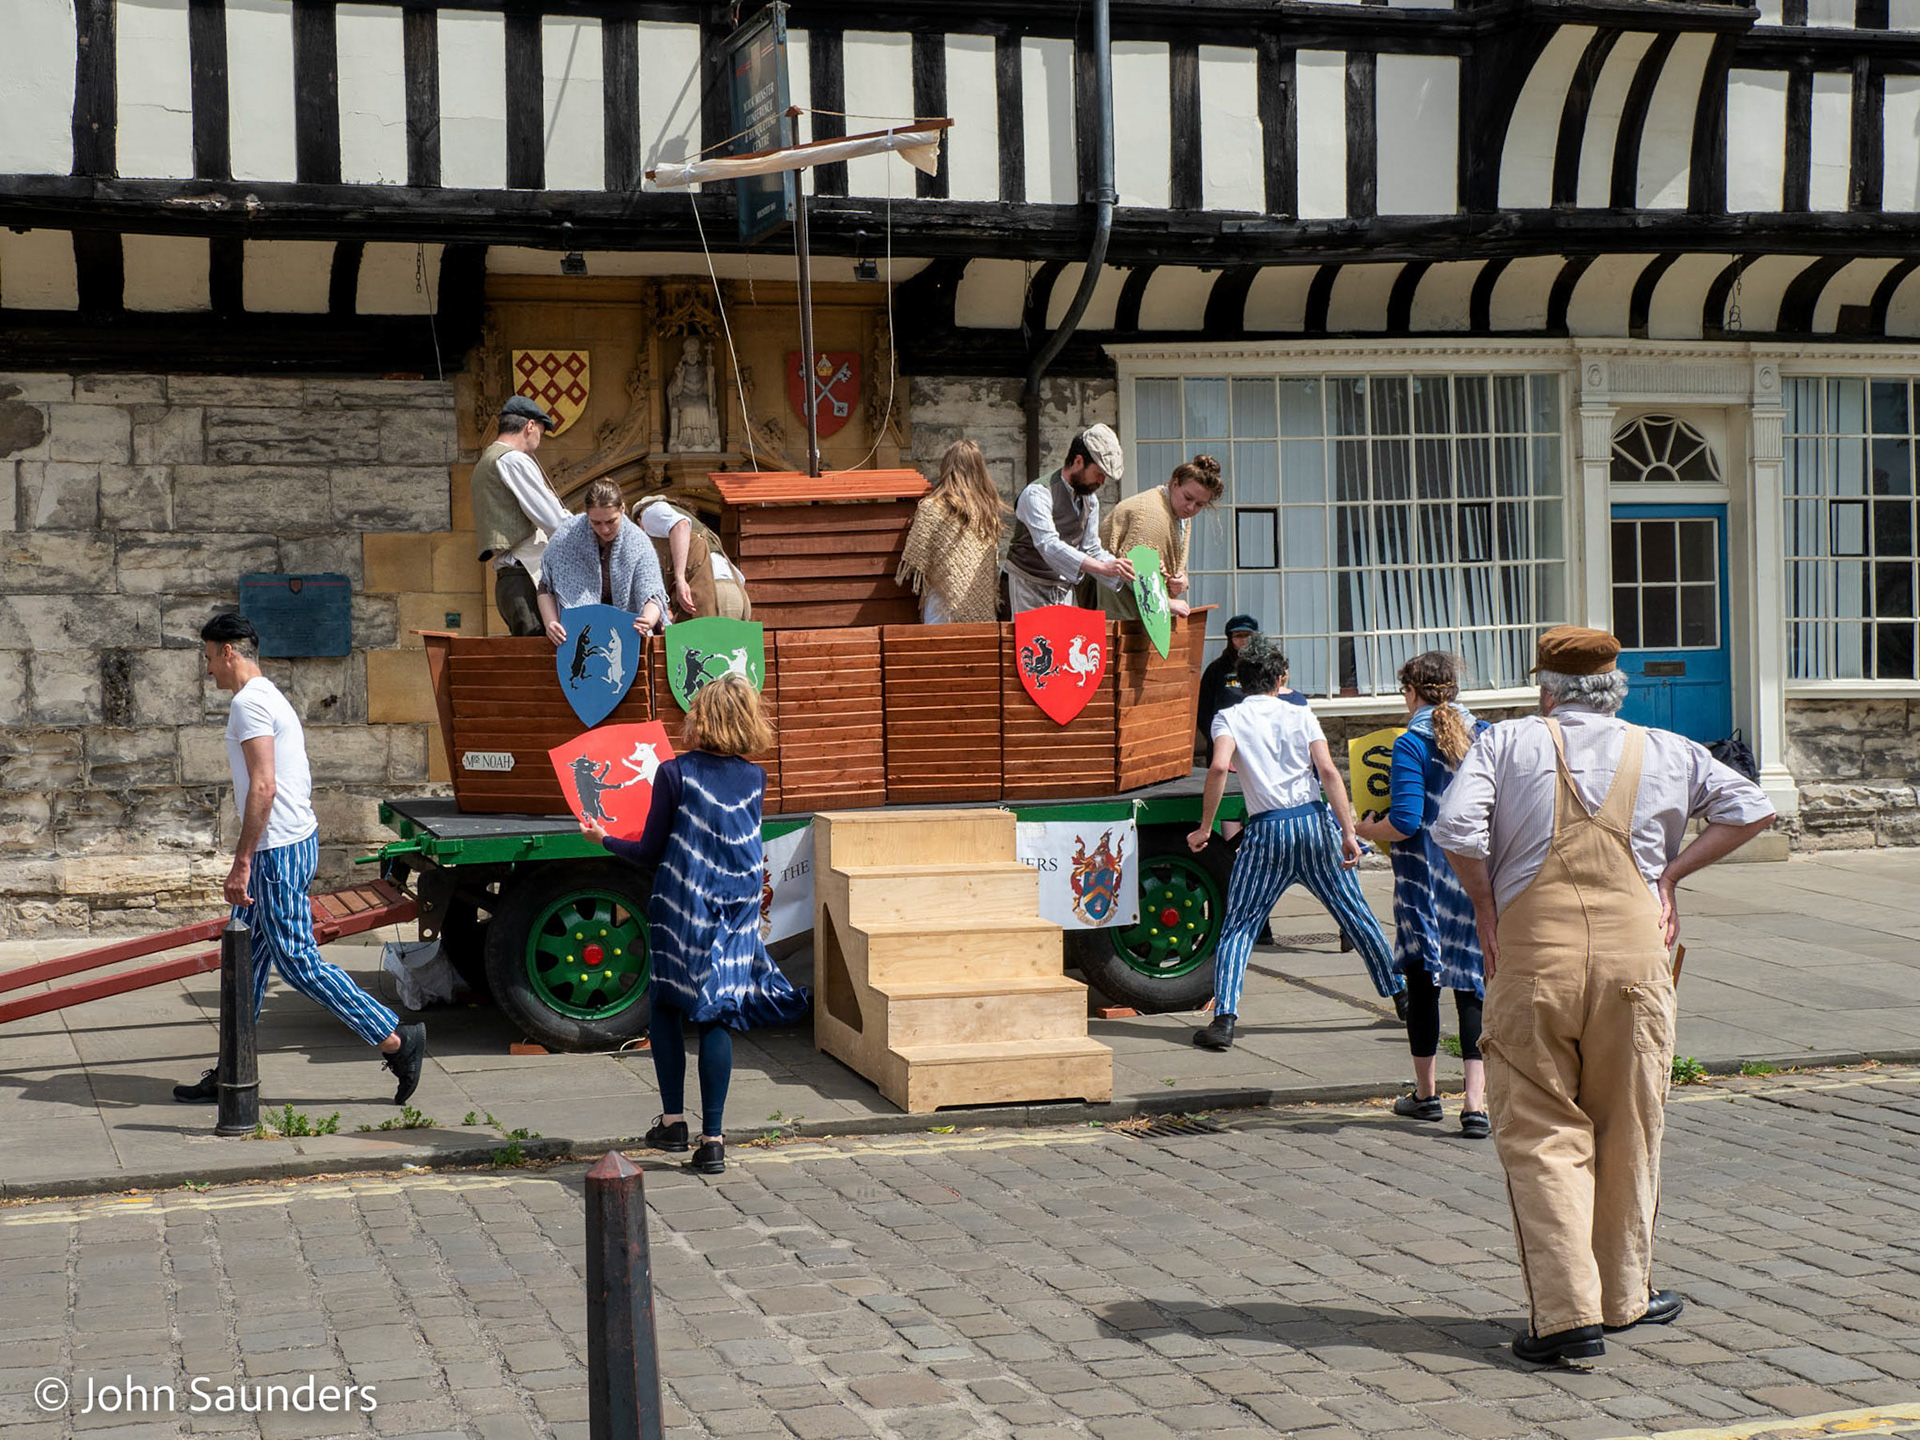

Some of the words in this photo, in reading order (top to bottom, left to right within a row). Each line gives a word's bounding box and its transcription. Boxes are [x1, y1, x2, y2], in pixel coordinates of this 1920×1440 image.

[745, 98, 774, 127] CONFERENCE
[752, 132, 770, 153] CENTRE
[483, 755, 510, 768] NOAH
[780, 860, 810, 882] THE
